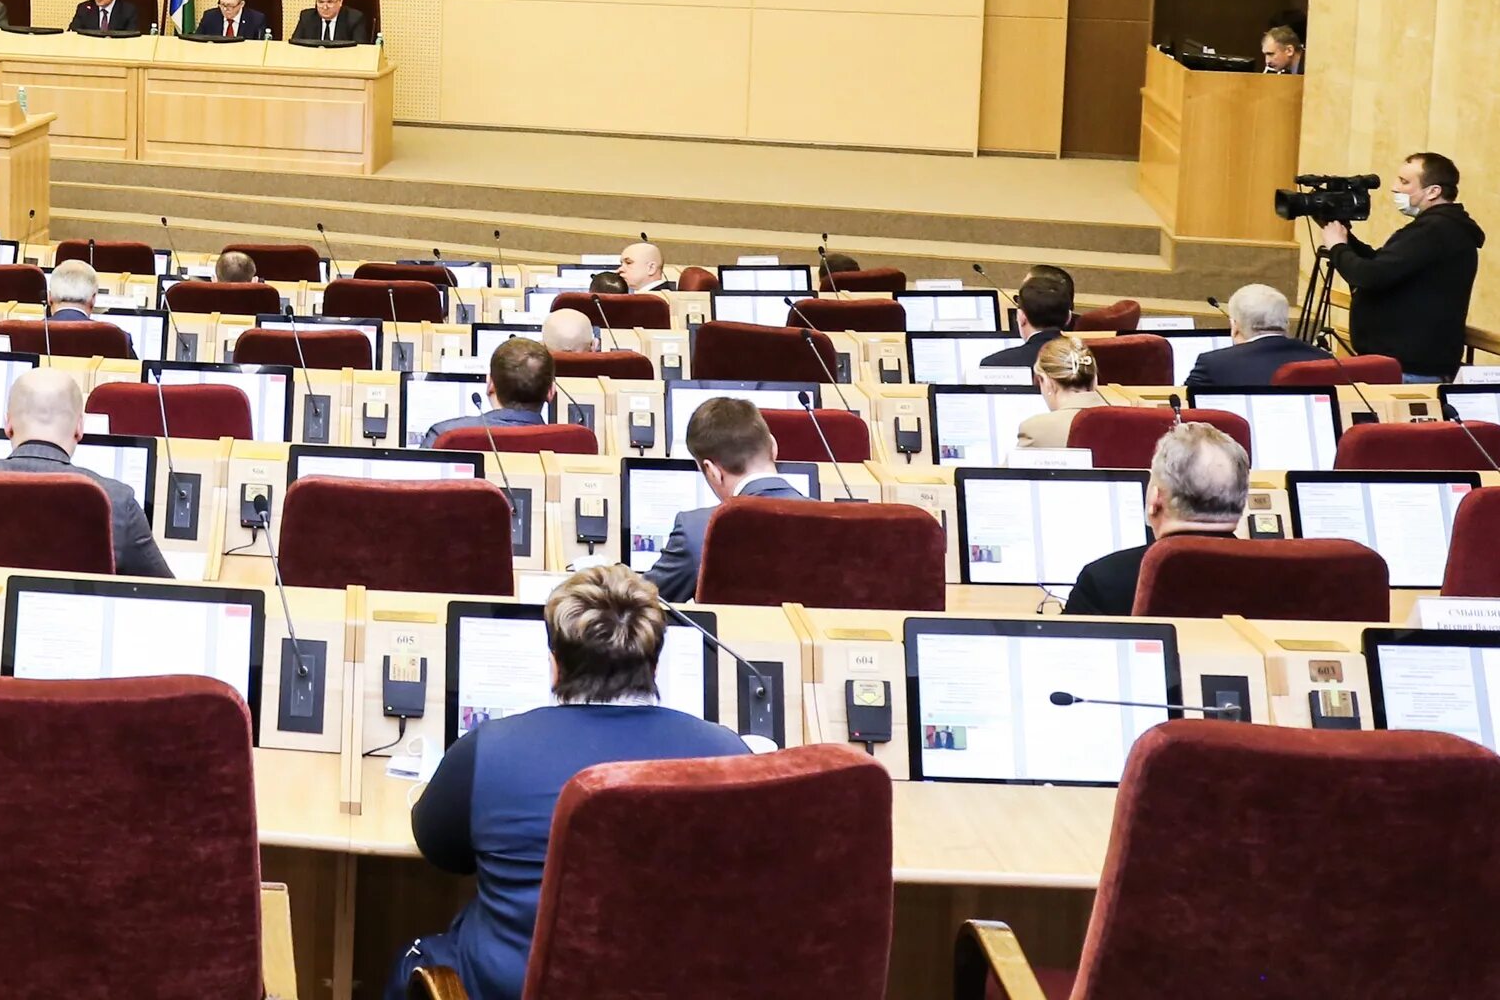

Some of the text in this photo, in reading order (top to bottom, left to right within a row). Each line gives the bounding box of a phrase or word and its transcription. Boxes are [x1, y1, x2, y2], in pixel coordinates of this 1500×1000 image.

[396, 635, 415, 645] 605
[855, 655, 874, 665] 604
[1317, 666, 1336, 676] 603
